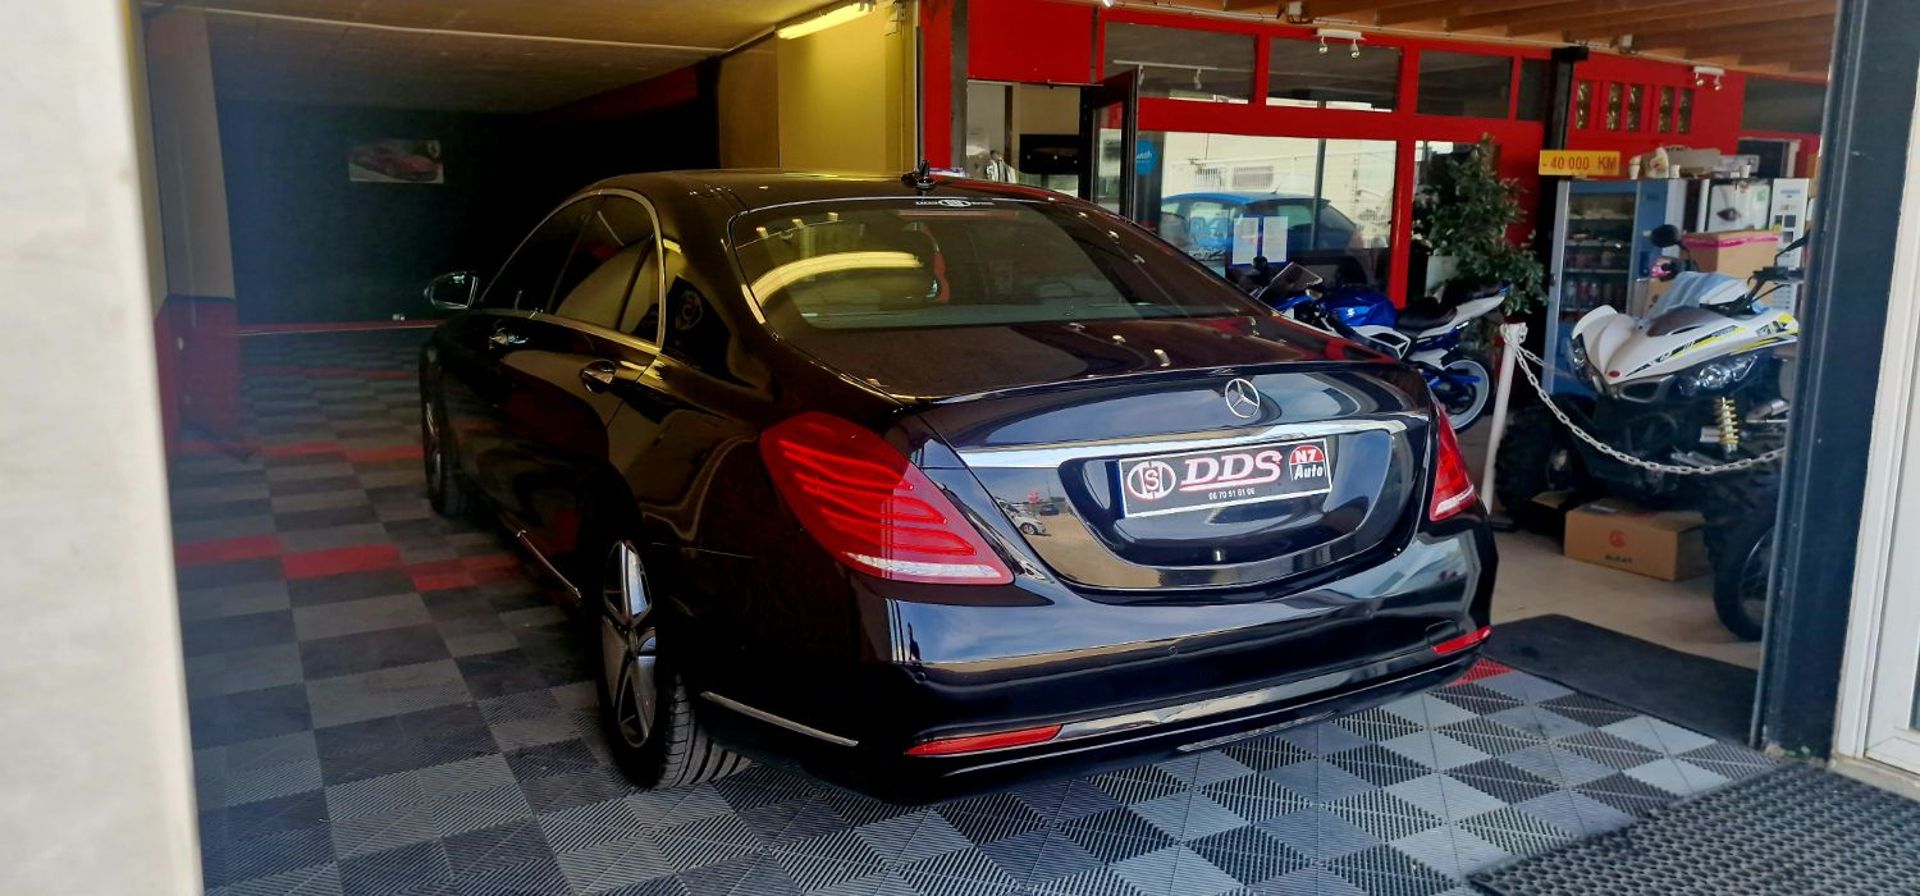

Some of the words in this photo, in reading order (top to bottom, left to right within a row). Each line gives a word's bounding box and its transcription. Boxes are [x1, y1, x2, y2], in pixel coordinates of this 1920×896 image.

[1551, 156, 1565, 170] 40
[1568, 156, 1590, 170] 000
[1597, 156, 1617, 170] KM
[1295, 449, 1317, 464] N7
[1179, 450, 1283, 491] DDS
[1293, 464, 1323, 481] Auto
